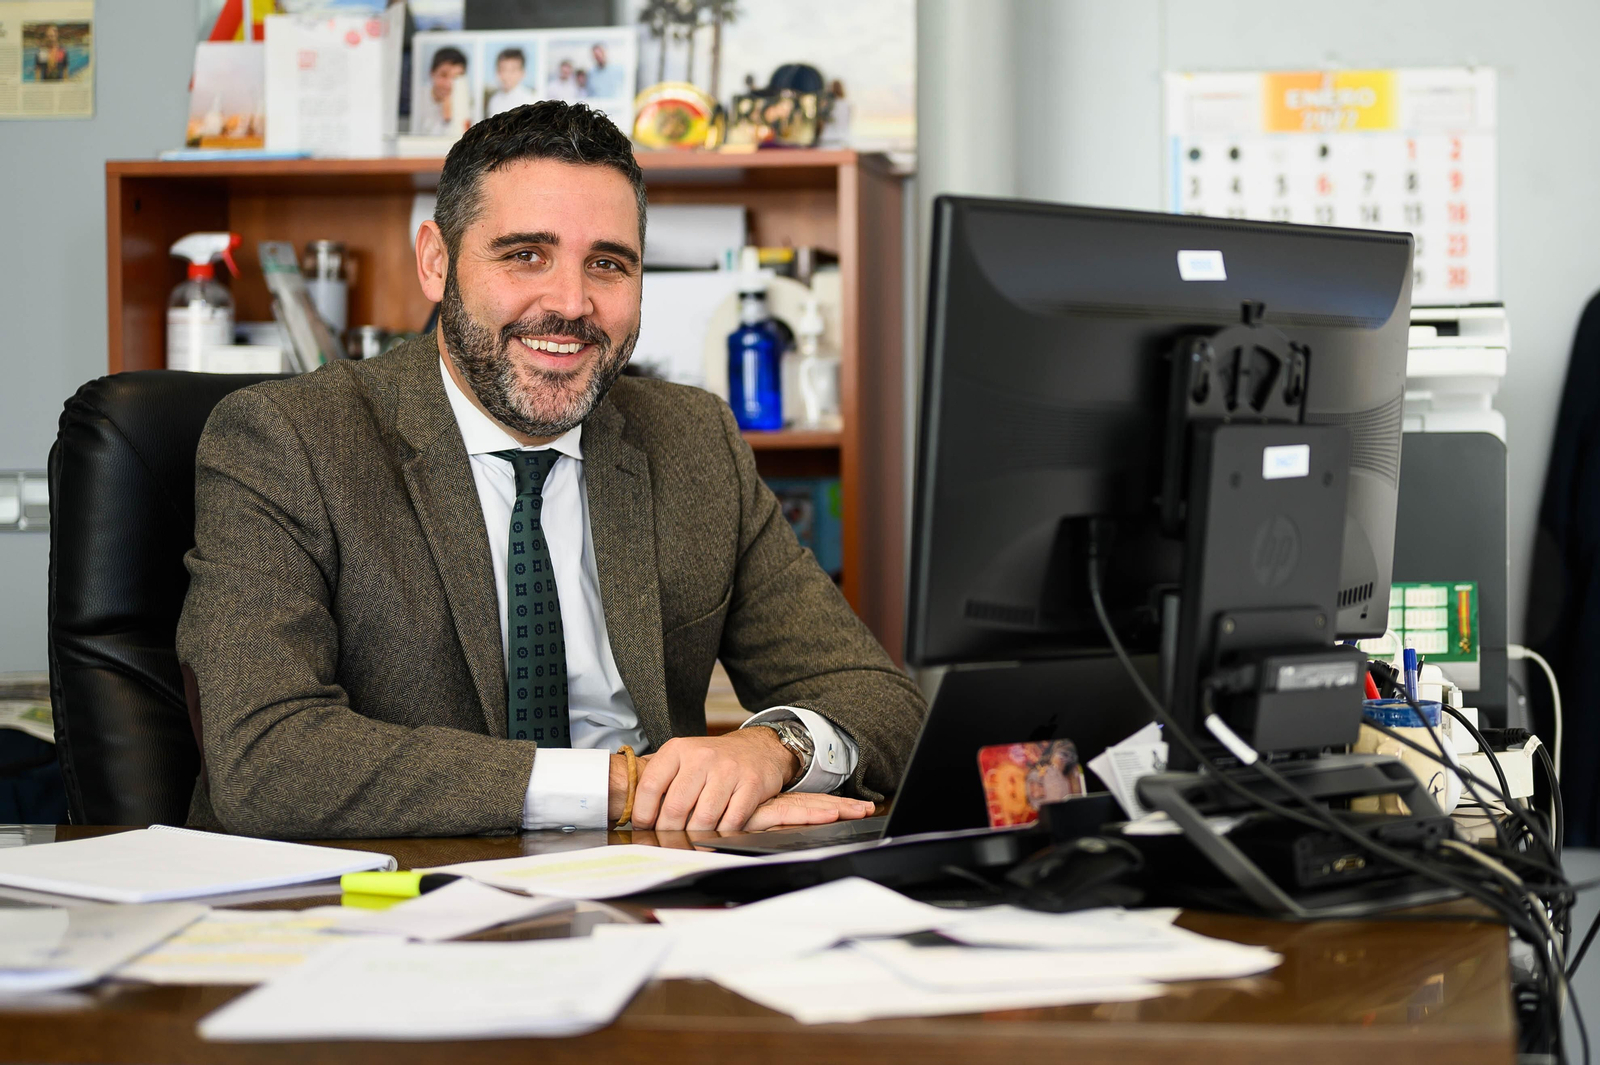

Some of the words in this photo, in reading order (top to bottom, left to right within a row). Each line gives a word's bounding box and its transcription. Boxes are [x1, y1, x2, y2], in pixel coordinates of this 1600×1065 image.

[1286, 88, 1376, 109] ENERO
[1405, 137, 1417, 160] 1
[1449, 136, 1463, 161] 2
[1229, 174, 1243, 196] 4
[1316, 173, 1336, 196] 6
[1362, 171, 1376, 195] 7
[1405, 171, 1420, 194] 8
[1448, 169, 1464, 193] 9
[1359, 203, 1382, 225] 14
[1446, 201, 1470, 226] 16
[1446, 233, 1470, 258] 23
[1446, 265, 1470, 289] 30
